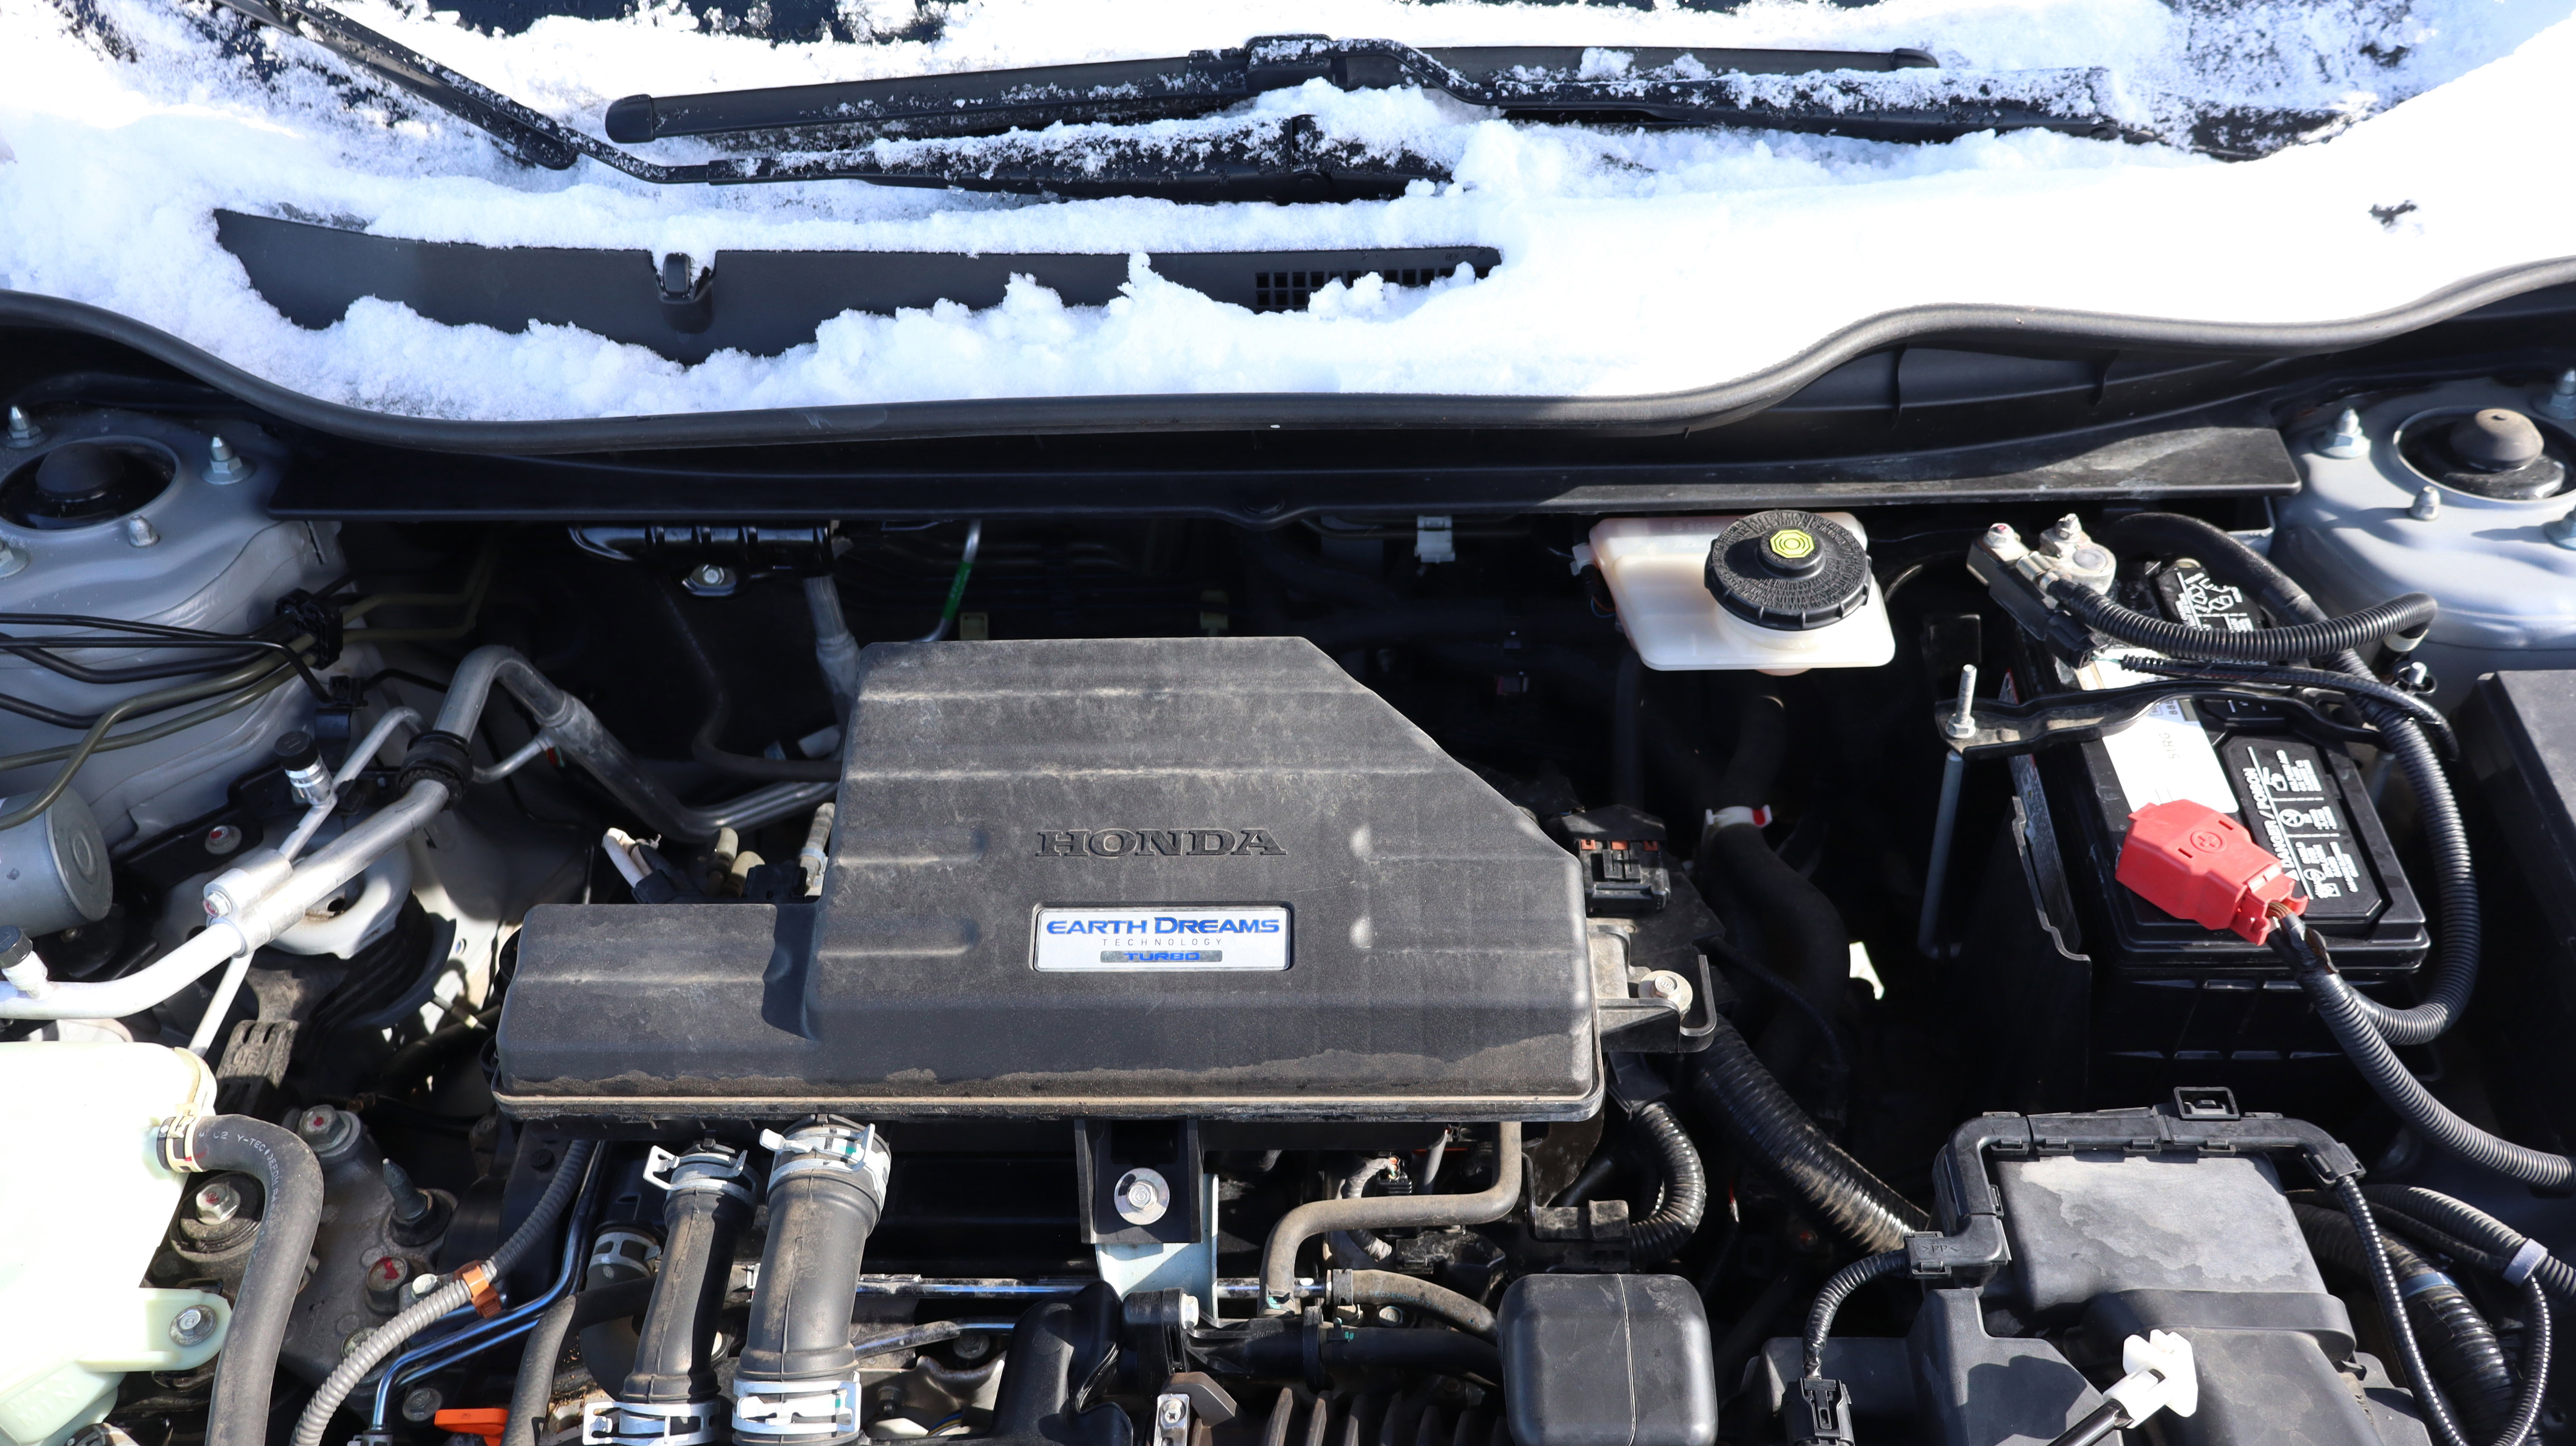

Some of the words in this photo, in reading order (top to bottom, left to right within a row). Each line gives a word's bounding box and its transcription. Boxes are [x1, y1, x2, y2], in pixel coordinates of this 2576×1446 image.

[2159, 732, 2180, 759] 51RG
[1035, 827, 1287, 857] HONDA
[1046, 920, 1146, 935] EARTH
[1154, 916, 1280, 934] DREAMS
[1102, 938, 1223, 946] TECHNOLOGY
[1124, 952, 1200, 961] TURBO
